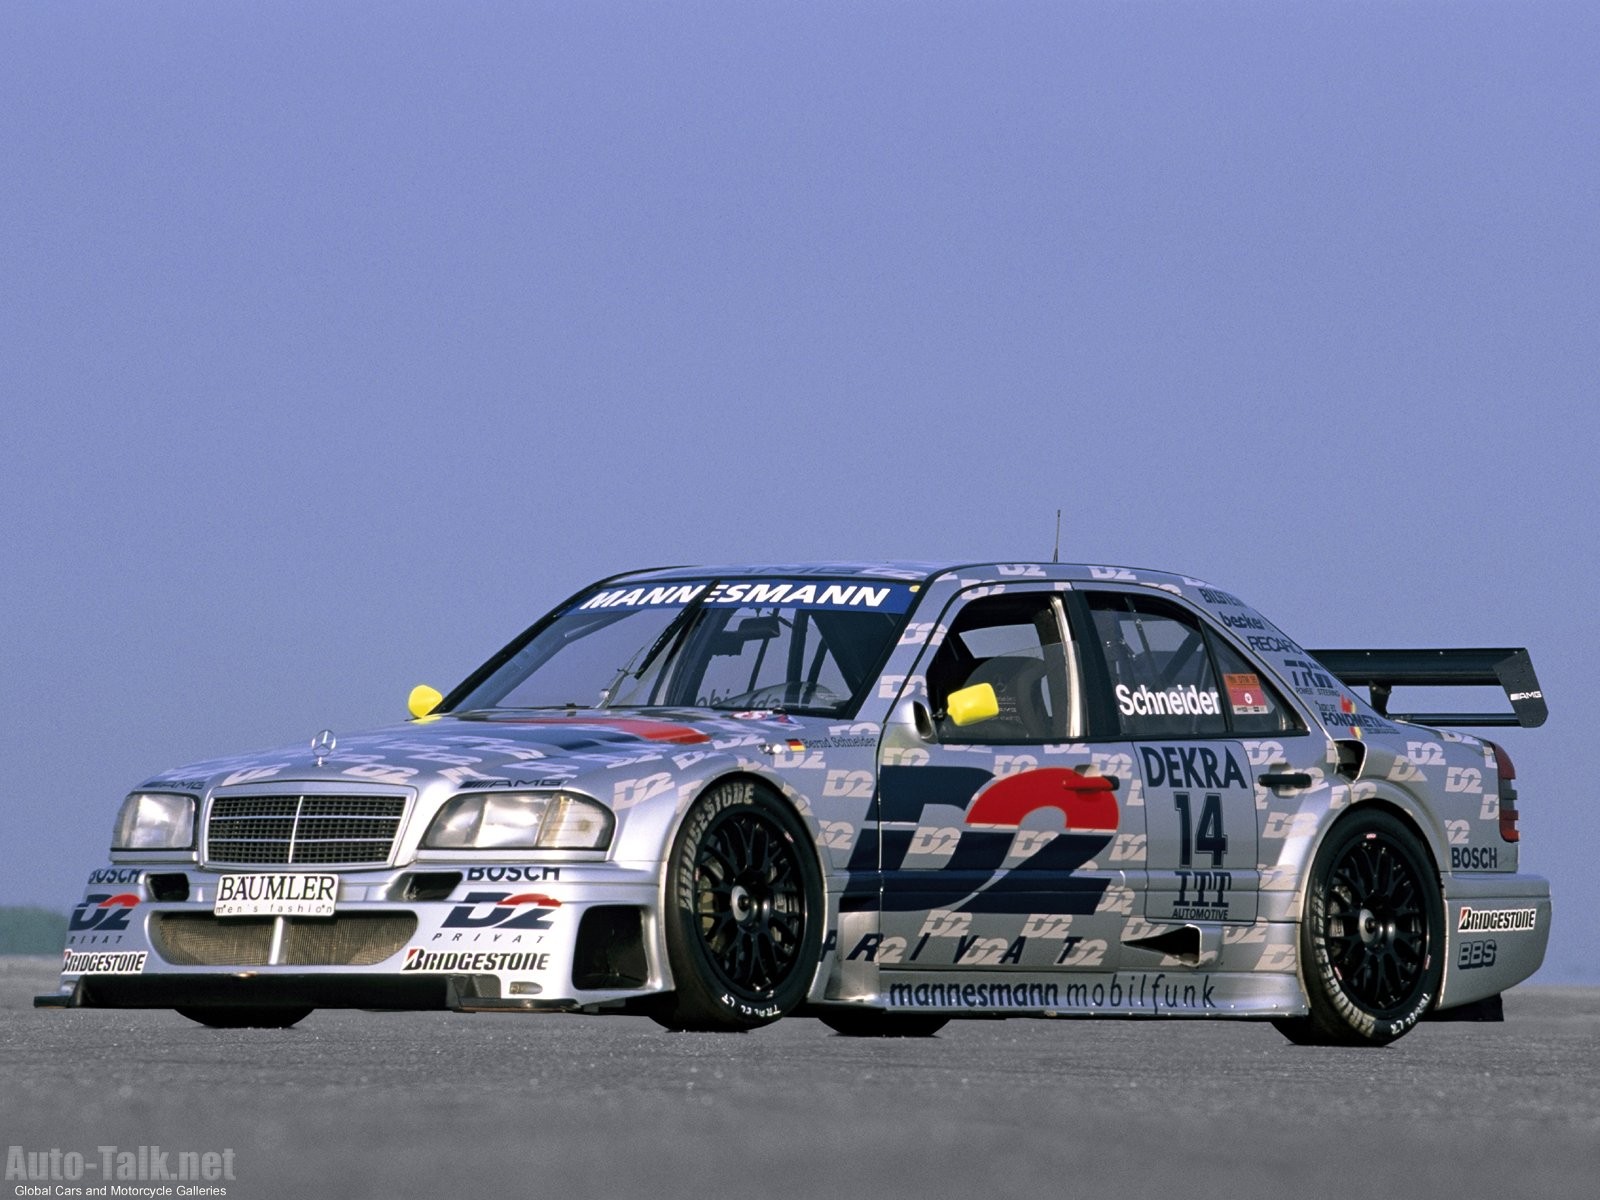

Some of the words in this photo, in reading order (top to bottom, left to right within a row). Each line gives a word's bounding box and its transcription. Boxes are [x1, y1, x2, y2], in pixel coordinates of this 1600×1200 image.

[579, 584, 890, 609] MANNESMANN
[1218, 611, 1271, 632] becke
[1116, 684, 1220, 716] Schneider
[1518, 690, 1542, 700] AMG
[1407, 741, 1446, 765] D2
[1139, 746, 1247, 789] DEKRA
[1445, 766, 1483, 793] D2
[488, 780, 562, 788] AMG
[613, 772, 676, 811] D2
[822, 769, 874, 797] D2
[839, 766, 1120, 915] D2
[908, 827, 961, 855] D2
[1173, 791, 1228, 869] 14
[1451, 847, 1497, 869] BOSCH
[88, 868, 142, 884] BOSCH
[466, 866, 560, 881] BOSCH
[218, 876, 336, 901] BÄUMLER
[68, 894, 141, 931] D2
[269, 903, 332, 914] fashion
[441, 891, 562, 930] D2
[1172, 908, 1228, 920] AUTOMOTIVE
[1458, 909, 1535, 930] BRIDGESTONE
[919, 910, 972, 936] D2
[1020, 914, 1073, 939] D2
[68, 935, 123, 945] RIVAT
[432, 932, 544, 944] PRIVAT
[402, 948, 551, 971] BRIDGESTONE
[1458, 939, 1497, 970] BBS
[890, 982, 1058, 1007] mannesmann
[1066, 974, 1216, 1015] mobilfunk
